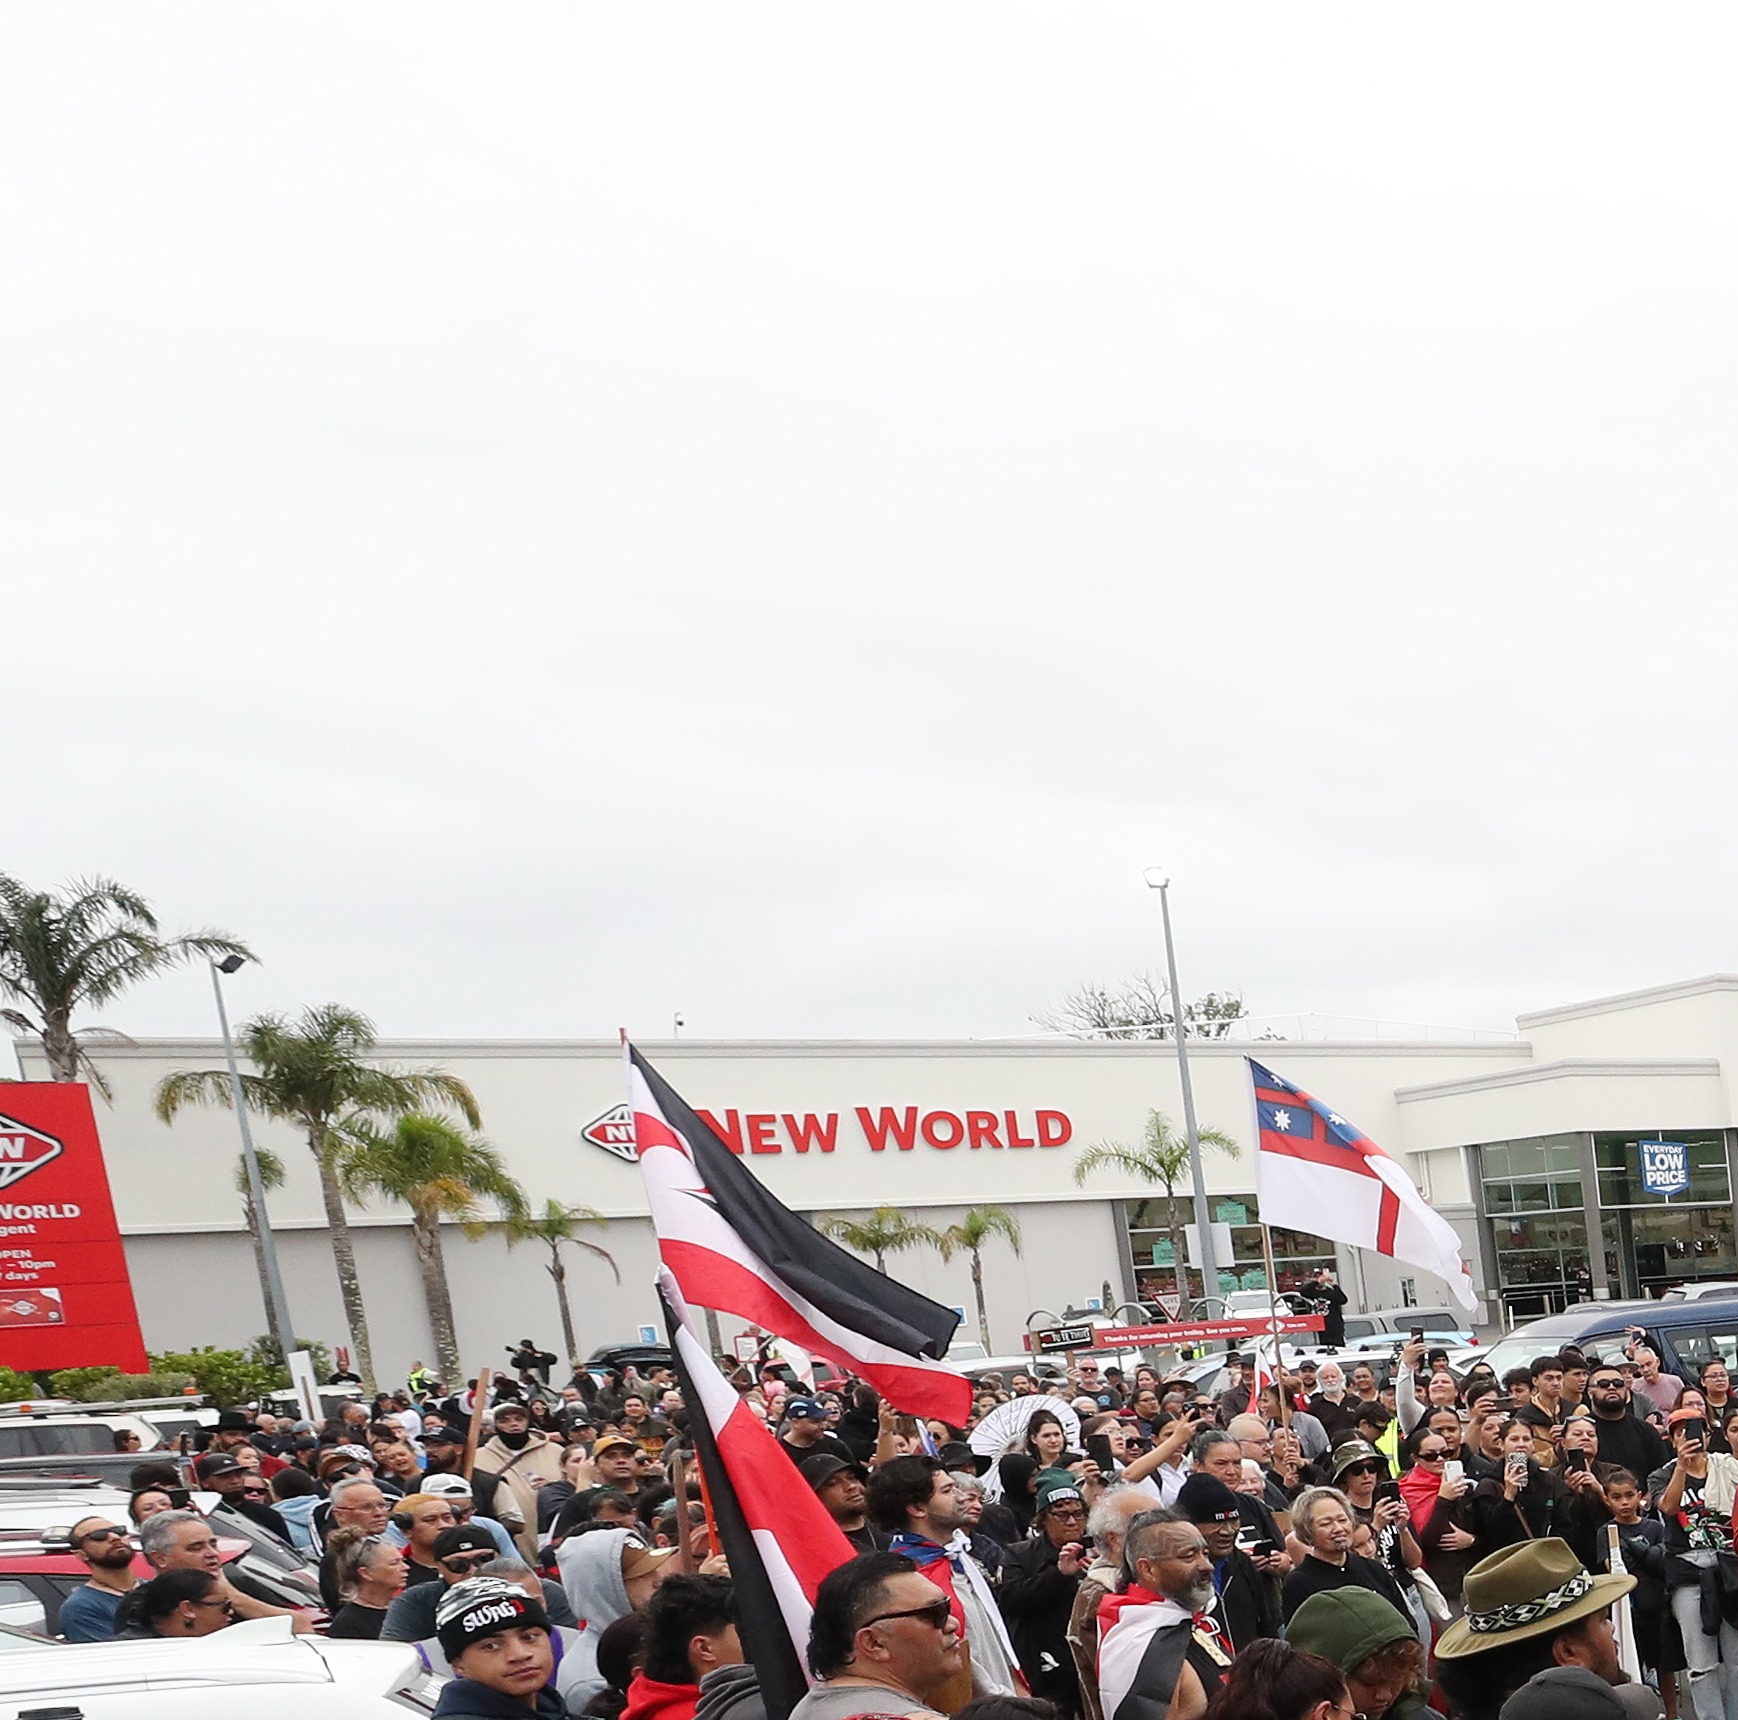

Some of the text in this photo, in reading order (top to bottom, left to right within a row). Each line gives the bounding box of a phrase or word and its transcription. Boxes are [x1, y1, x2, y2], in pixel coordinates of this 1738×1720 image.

[694, 1106, 1073, 1155] NEW WORLD
[1643, 1144, 1684, 1155] EVERYDAY
[1643, 1153, 1684, 1172] LOW
[1646, 1168, 1687, 1187] PRICE
[0, 1223, 37, 1237] gent
